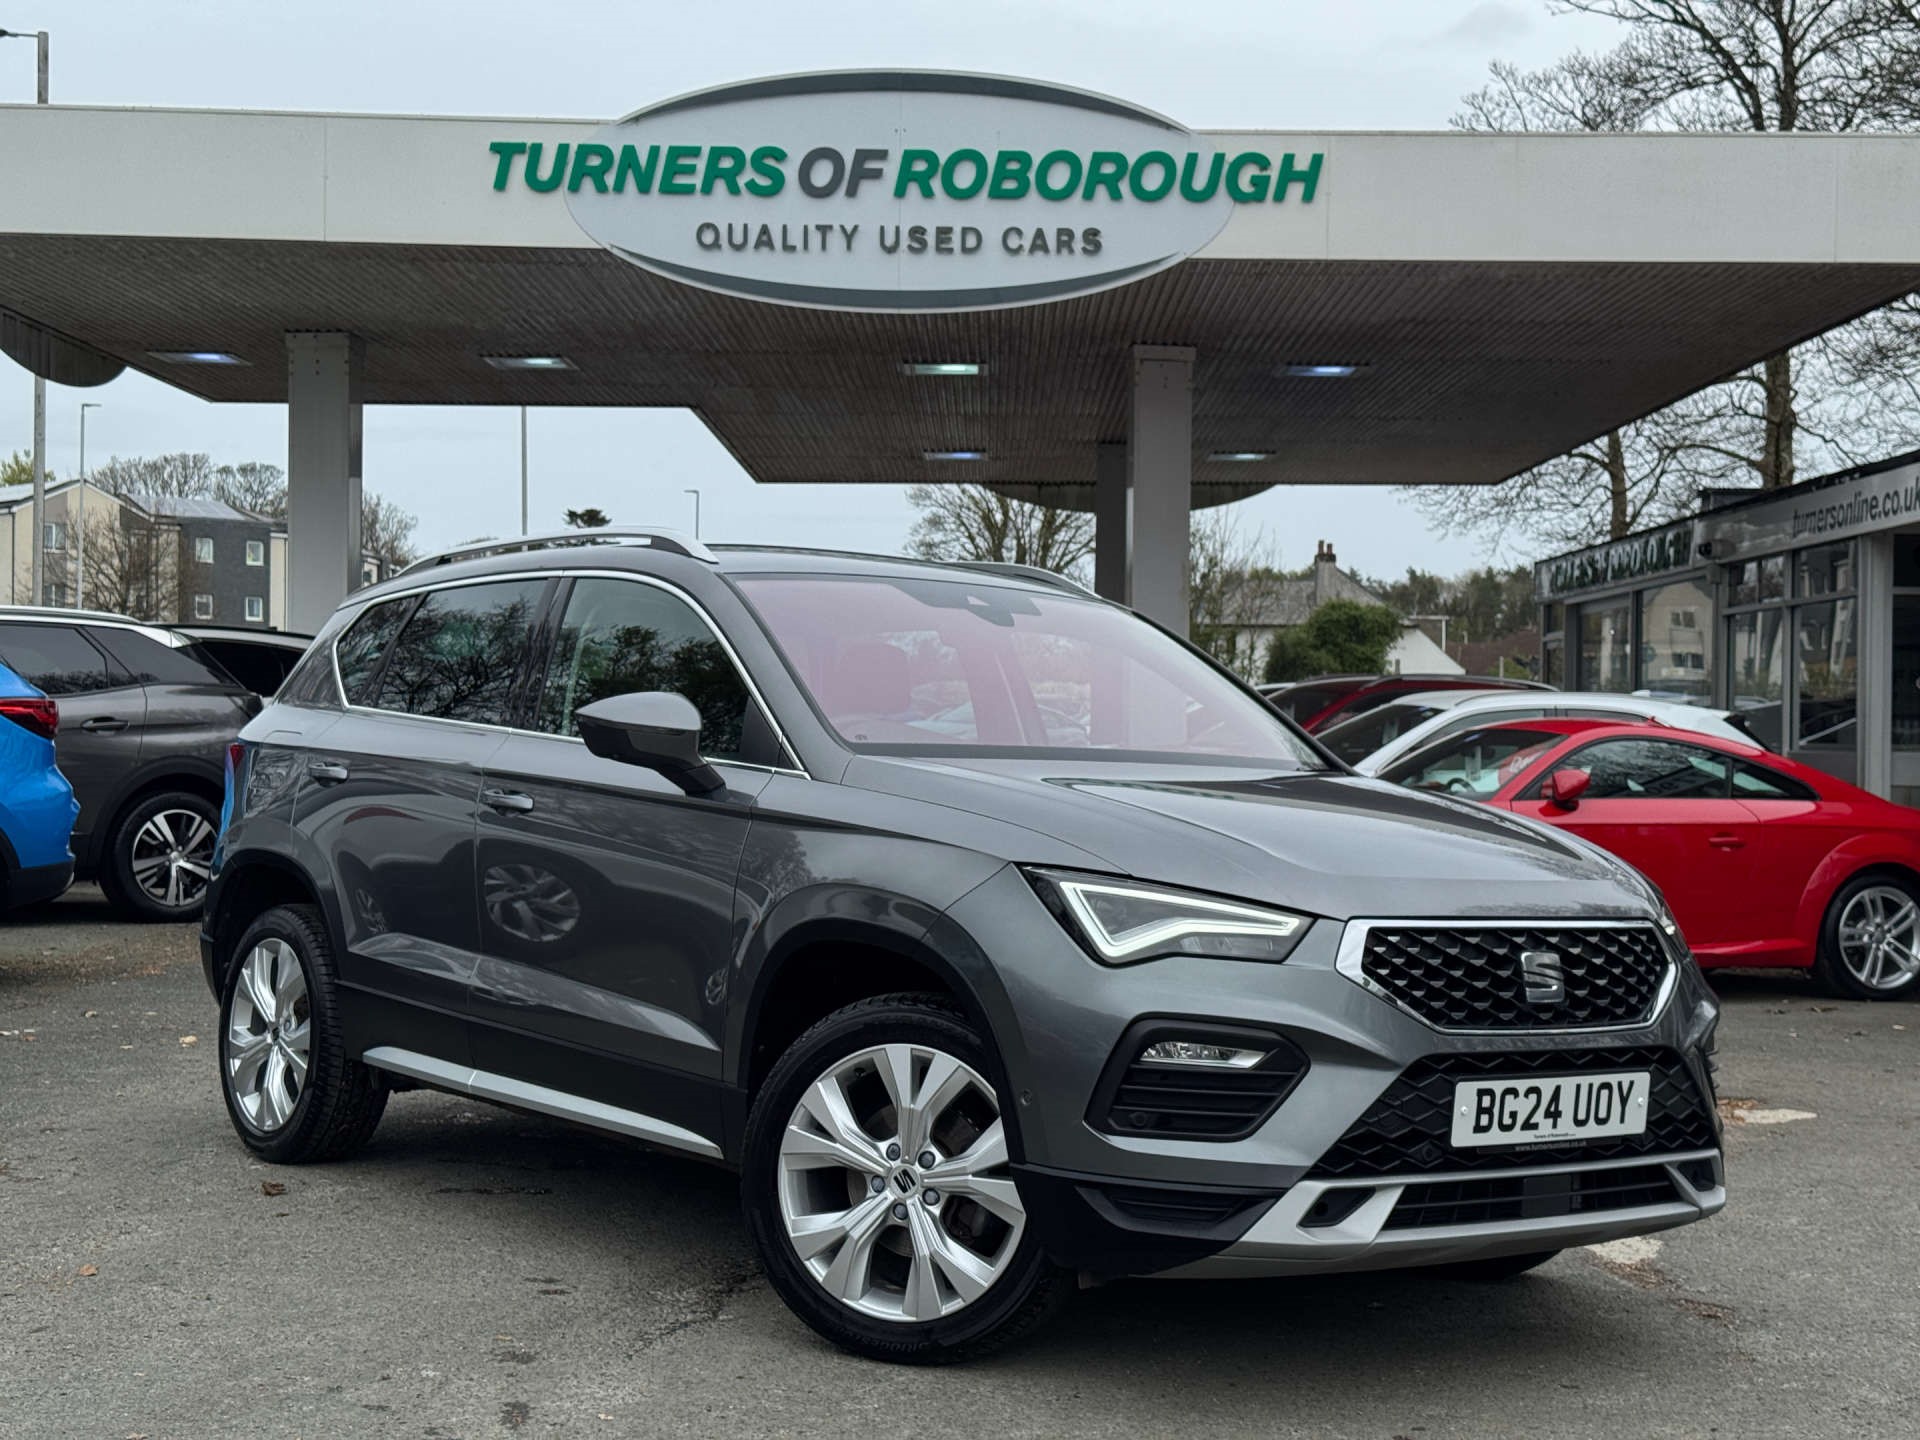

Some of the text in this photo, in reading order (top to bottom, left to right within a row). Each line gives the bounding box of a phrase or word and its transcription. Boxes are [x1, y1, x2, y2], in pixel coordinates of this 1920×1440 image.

[488, 140, 1325, 204] TURNERS OF ROBOROUGH
[695, 222, 1103, 257] QUALITY USED CARS
[1792, 475, 1920, 538] turnersonline.co.uk
[1472, 1079, 1636, 1134] BG24 UOY
